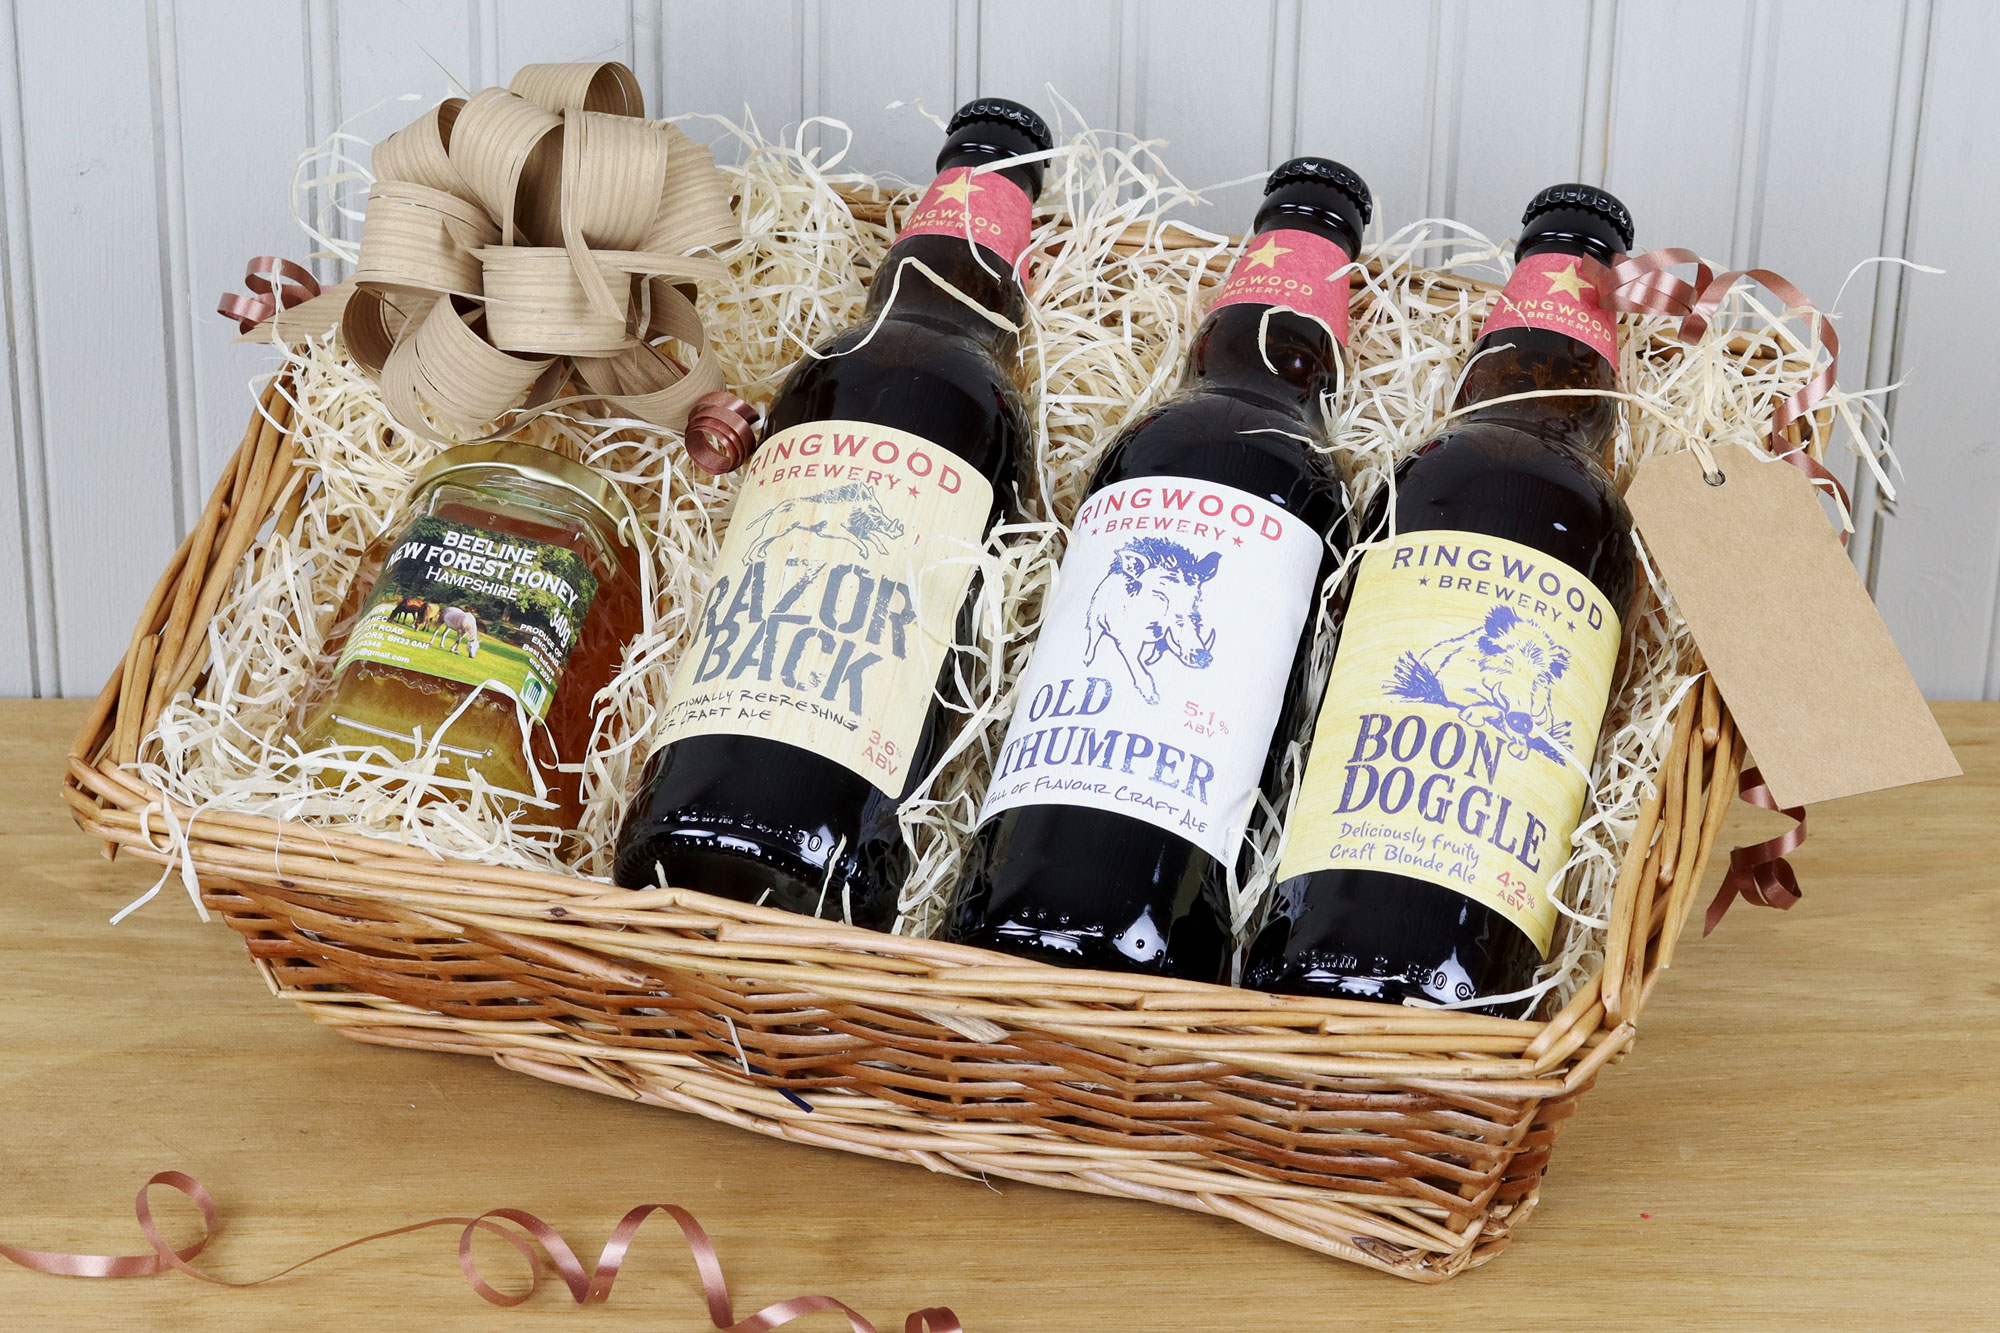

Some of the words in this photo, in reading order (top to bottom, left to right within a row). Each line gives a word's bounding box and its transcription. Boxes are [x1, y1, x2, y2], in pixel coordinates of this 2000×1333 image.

[907, 209, 1002, 235] INGWOOD
[912, 219, 972, 229] BREWER
[1222, 275, 1314, 296] NGWOOD
[1502, 299, 1612, 343] RINGWOOD
[1526, 311, 1592, 334] BREWERY
[747, 433, 963, 494] RINGWOOD
[772, 463, 902, 491] BREWERY
[1078, 487, 1284, 542] RINGWOOD
[1104, 515, 1227, 541] BREWERY
[442, 530, 538, 566] BEELINE
[386, 541, 425, 570] NEW
[424, 545, 512, 579] FOREST
[511, 563, 579, 609] HONEY
[425, 565, 521, 601] HAMPSHIRE
[1392, 544, 1604, 632] RINGWOOD
[691, 558, 918, 660] RAZOR
[1437, 574, 1563, 624] BREWERY
[378, 624, 404, 635] ROAD
[387, 635, 410, 646] BH22
[520, 623, 555, 650] PRODUCE
[554, 647, 563, 658] OF
[549, 607, 571, 648] 340g
[522, 643, 539, 658] Best
[538, 654, 555, 676] before
[529, 657, 541, 671] end
[693, 619, 884, 717] BACK
[664, 690, 734, 721] EPTIONALLY
[740, 689, 859, 731] REFRESHING
[738, 707, 772, 721] ALE
[1028, 676, 1113, 723] OLD
[1184, 719, 1215, 738] ABV
[862, 745, 898, 776] ABV
[998, 726, 1216, 806] THUMPER
[1346, 713, 1508, 786] BOON
[1010, 782, 1031, 794] OF
[1034, 775, 1112, 795] FLAVOUR
[1114, 785, 1180, 817] CRAFT
[1179, 808, 1209, 835] ALE
[1331, 764, 1548, 874] DOGGLE
[1338, 820, 1427, 852] Deliciously
[1329, 841, 1376, 862] Craft
[1384, 843, 1444, 873] Blonde
[1448, 862, 1477, 885] Ale
[1496, 890, 1524, 912] ABV
